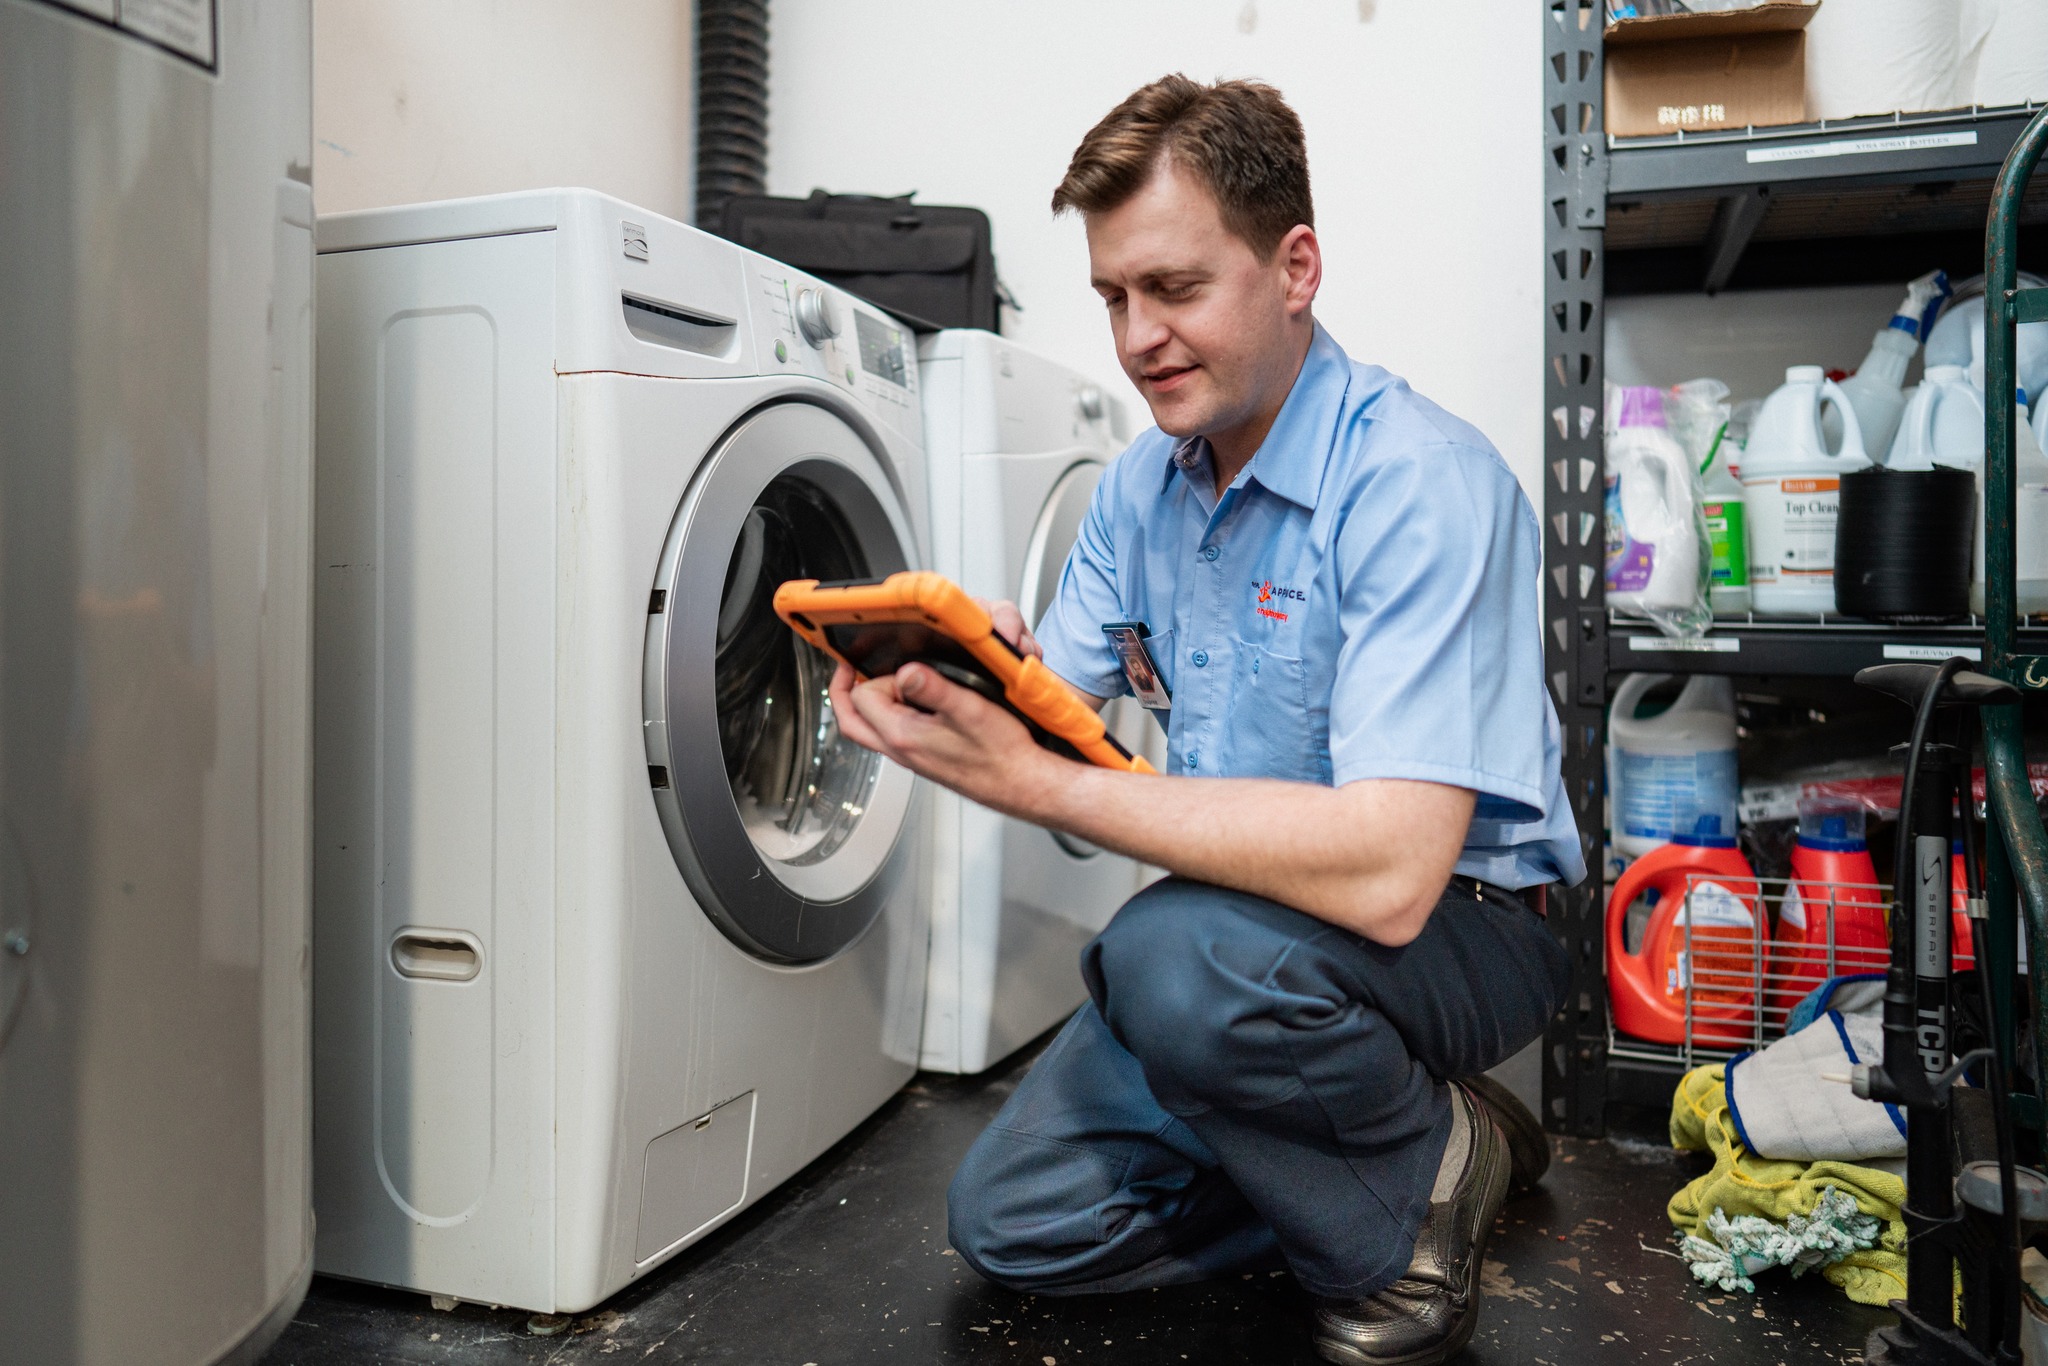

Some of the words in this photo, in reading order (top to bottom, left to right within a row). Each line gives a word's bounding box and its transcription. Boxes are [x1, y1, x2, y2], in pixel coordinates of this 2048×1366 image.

[1785, 501, 1806, 516] Top
[1809, 501, 1839, 513] Clean
[1928, 893, 1937, 963] SERFAS
